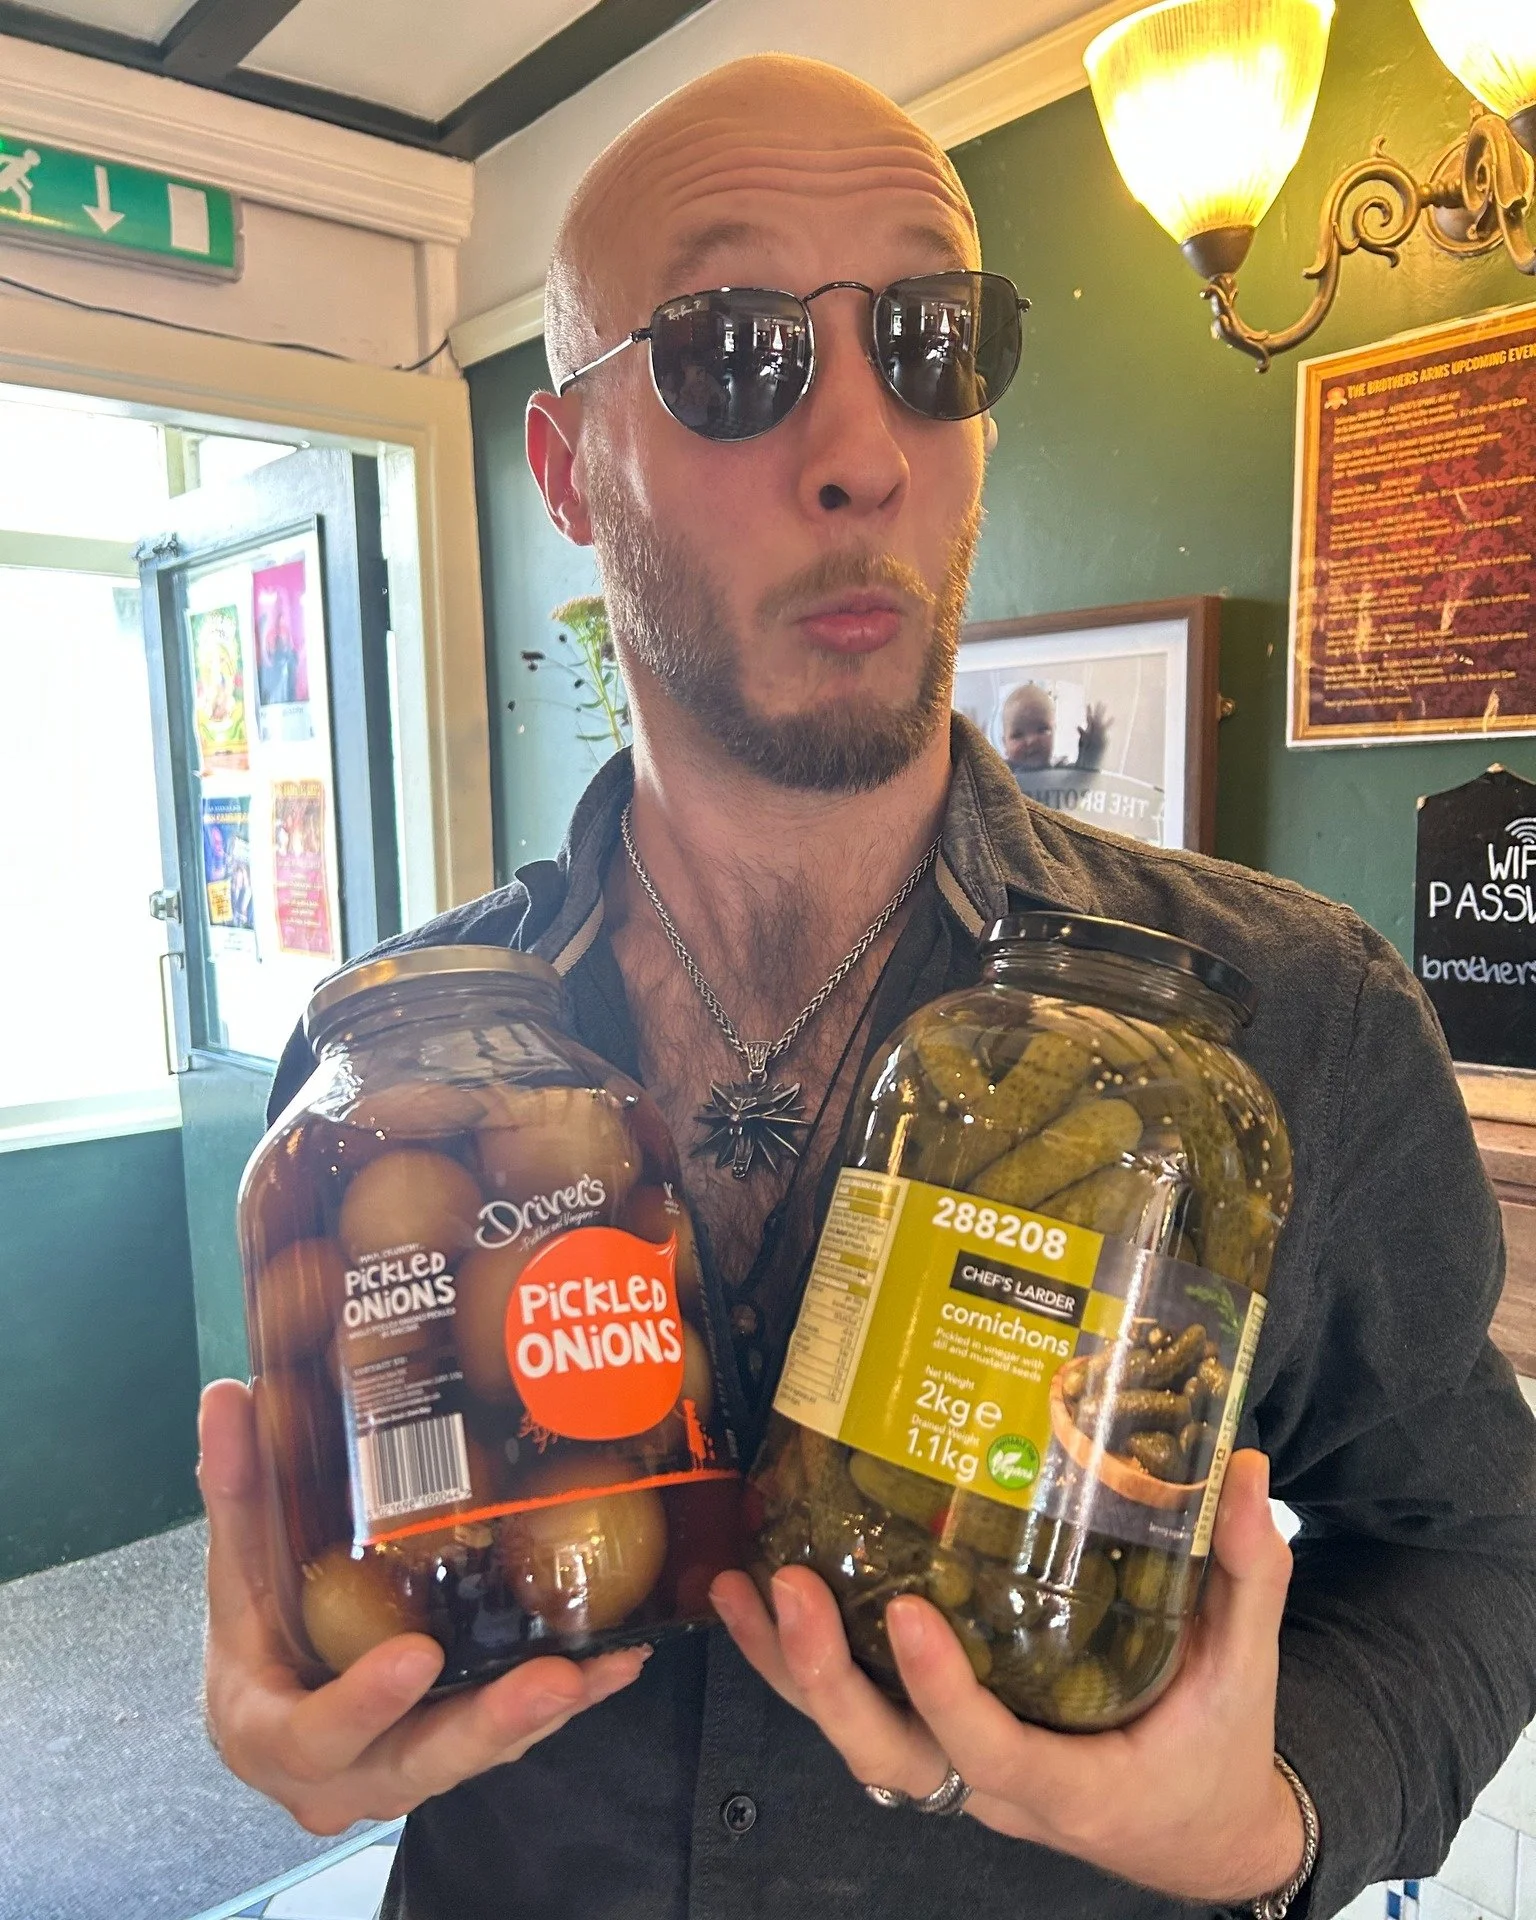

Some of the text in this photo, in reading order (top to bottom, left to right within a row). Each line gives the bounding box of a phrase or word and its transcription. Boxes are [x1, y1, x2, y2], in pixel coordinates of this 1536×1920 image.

[1347, 383, 1367, 399] THE
[1366, 371, 1419, 395] BROTHERS
[1420, 363, 1450, 383] ARMS
[1451, 350, 1507, 375] UPCOMING
[1488, 843, 1536, 880] WIF
[474, 1174, 606, 1249] Driver's
[932, 1196, 1068, 1260] 288208
[961, 1264, 1075, 1312] CHEF'S LARDER
[936, 1327, 1045, 1370] Pickled in vinegar with
[941, 1303, 1070, 1357] cornichons
[925, 1364, 975, 1391] Net Weight
[932, 1339, 1042, 1383] dill and mustard seeds
[915, 1379, 970, 1427] 2kg
[911, 1413, 980, 1447] Drained Weight
[907, 1427, 979, 1483] 1.1kg
